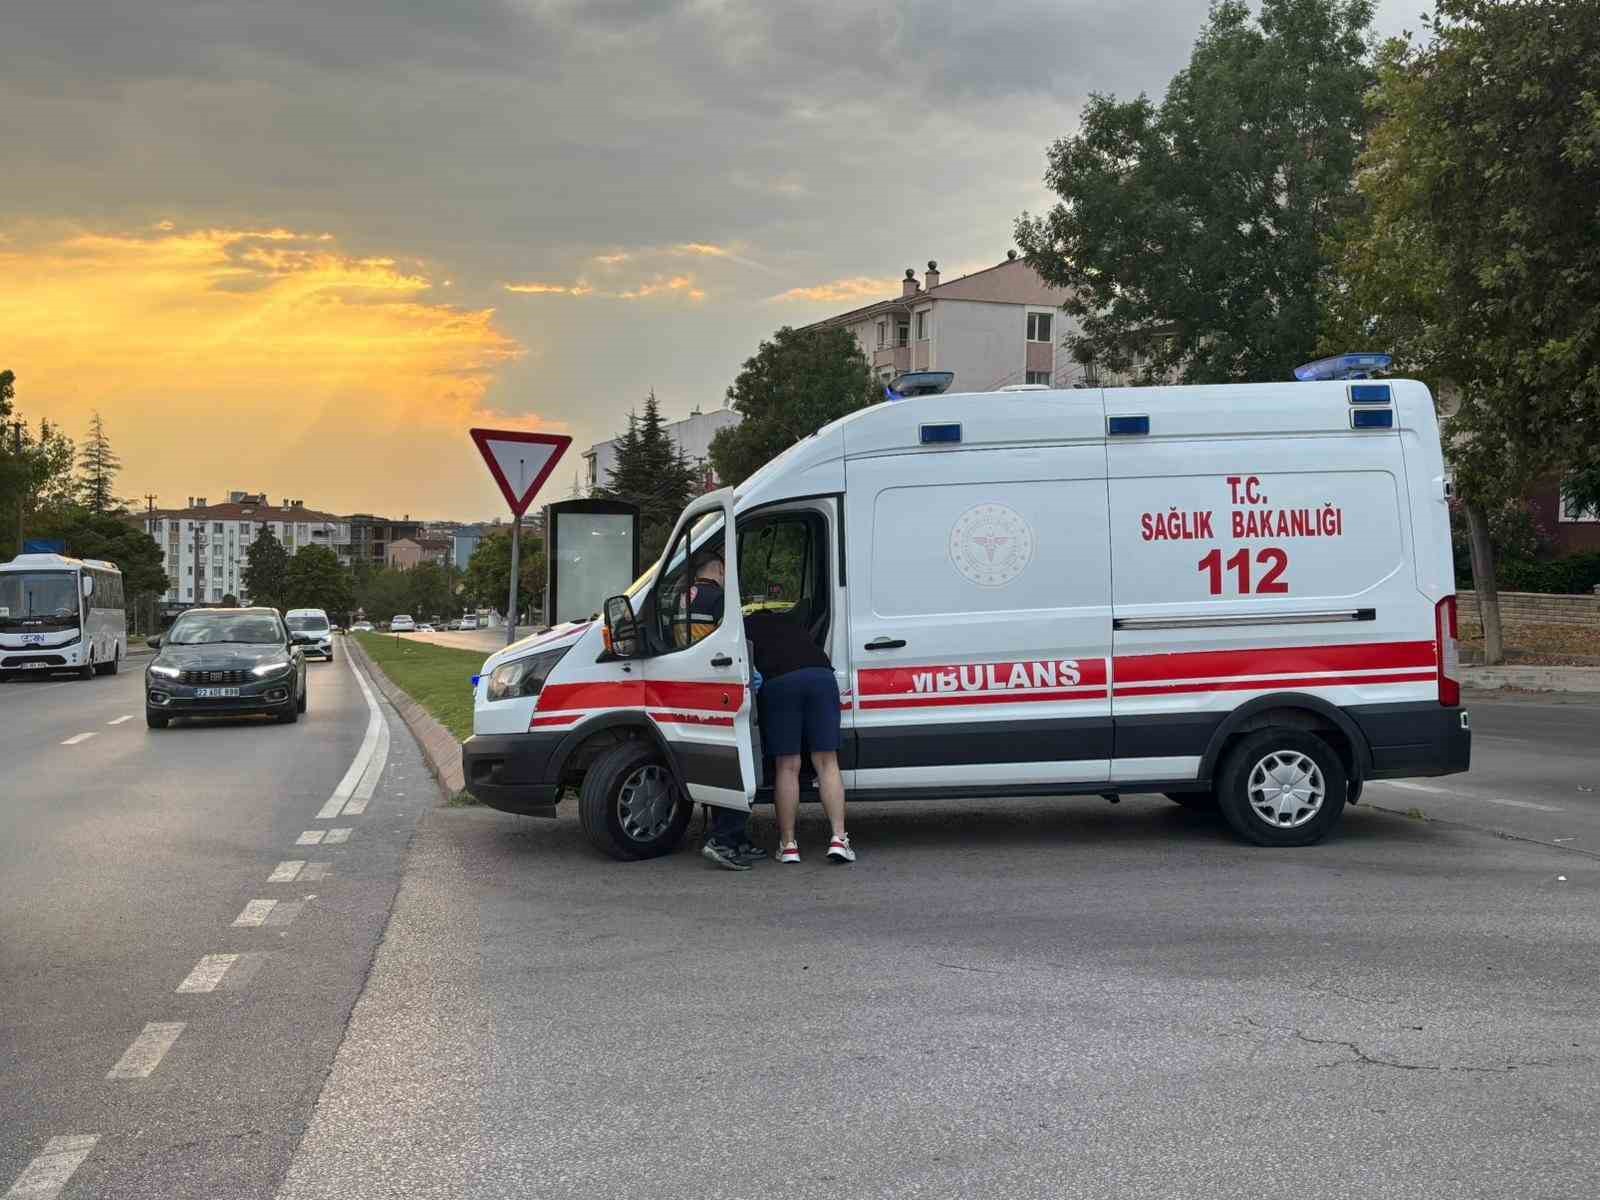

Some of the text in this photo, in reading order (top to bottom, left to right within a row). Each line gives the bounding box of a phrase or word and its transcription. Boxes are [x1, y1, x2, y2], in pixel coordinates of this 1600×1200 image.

[1226, 476, 1268, 505] T.C.
[1141, 502, 1342, 541] SAĞLIK BAKANLIĞI
[1198, 547, 1288, 595] 112
